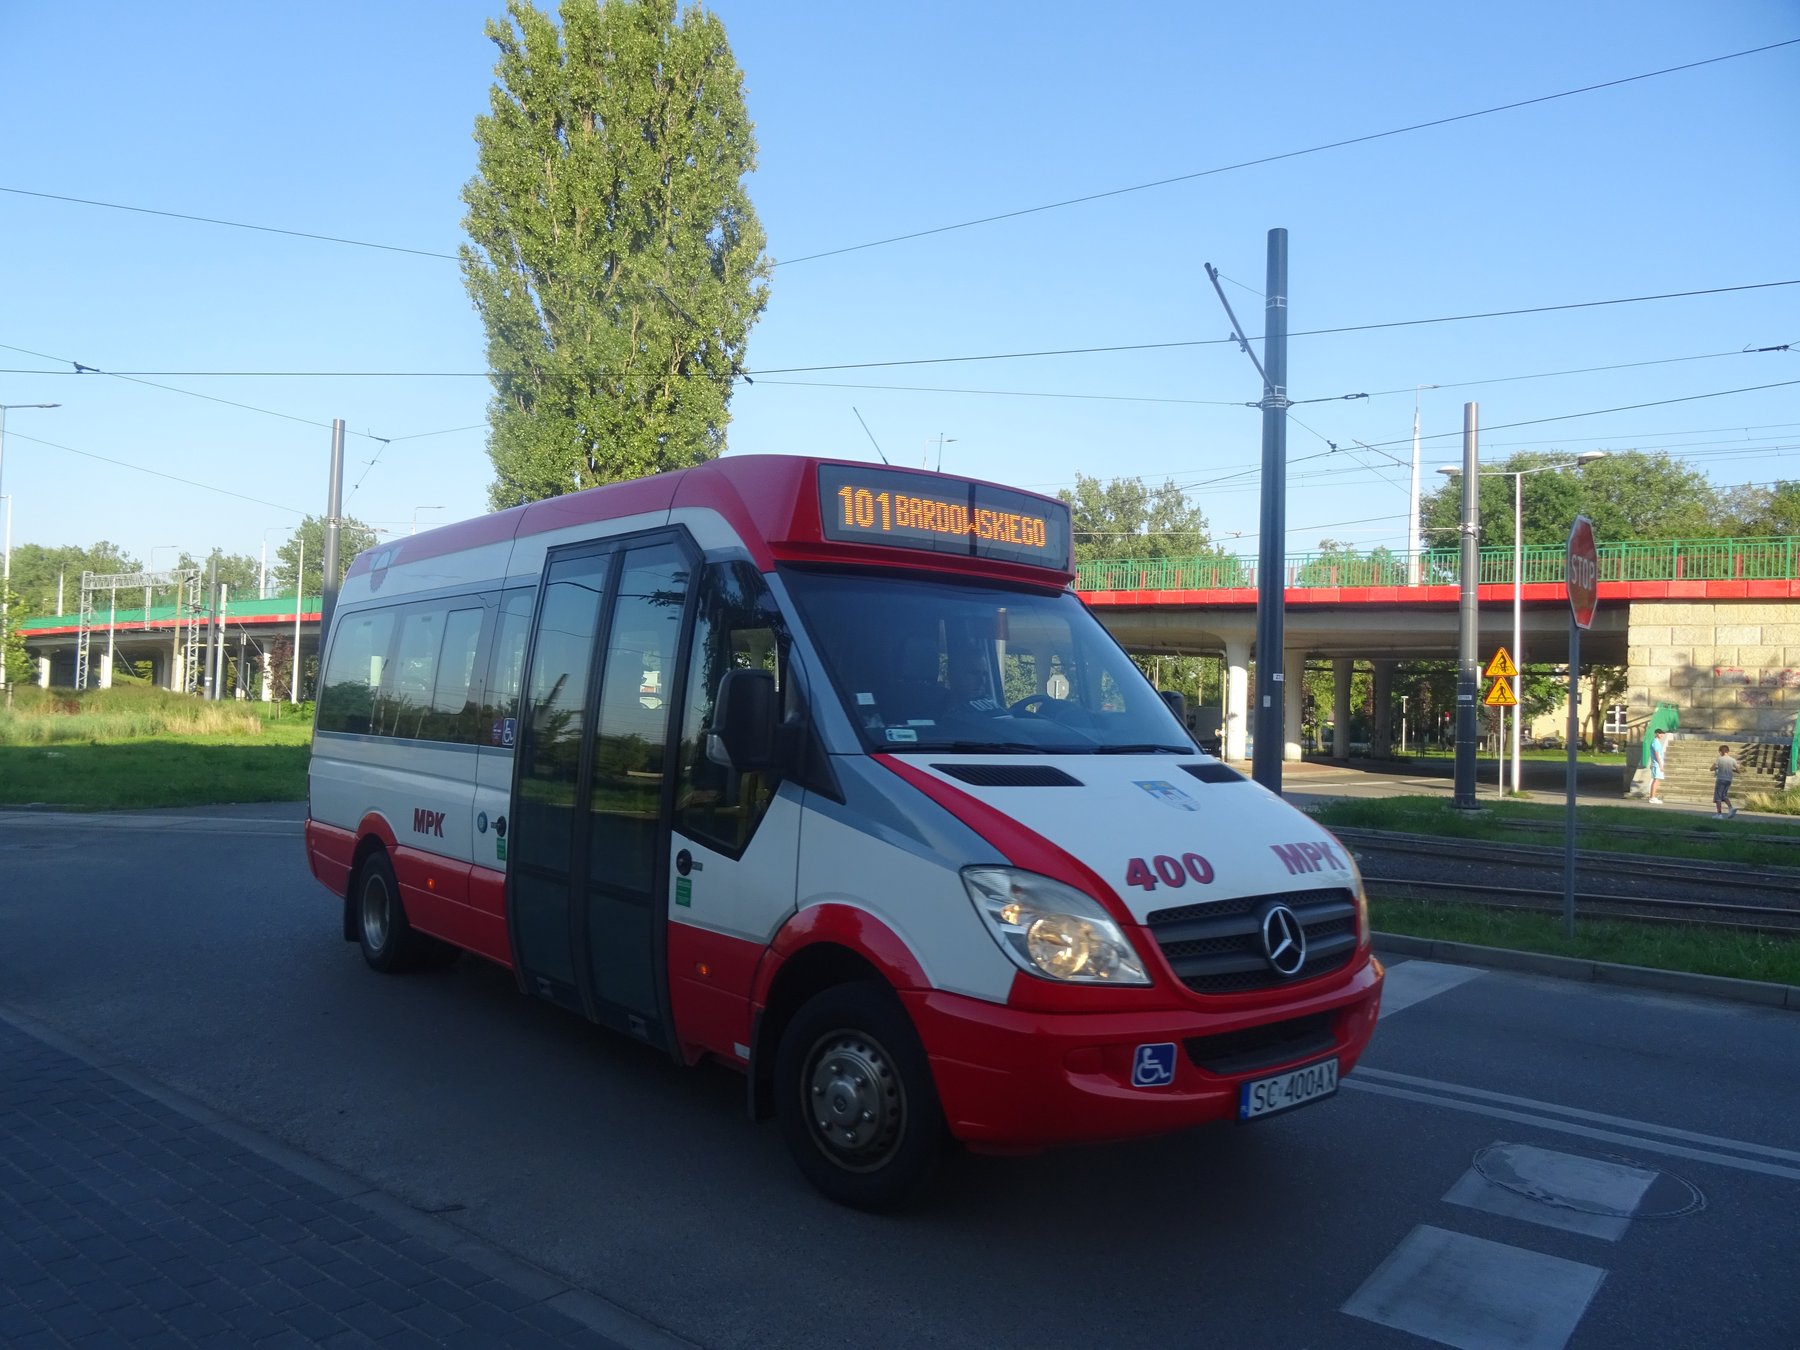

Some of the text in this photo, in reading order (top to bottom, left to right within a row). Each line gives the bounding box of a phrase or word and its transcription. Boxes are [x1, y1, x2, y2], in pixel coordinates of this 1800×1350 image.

[838, 486, 1046, 547] 101 BARDOWSKIEGO
[1571, 554, 1595, 591] STOP
[413, 807, 446, 838] MPK
[1126, 852, 1215, 891] 400
[1269, 841, 1347, 875] MPK
[1253, 1062, 1335, 1111] SC 400AX
